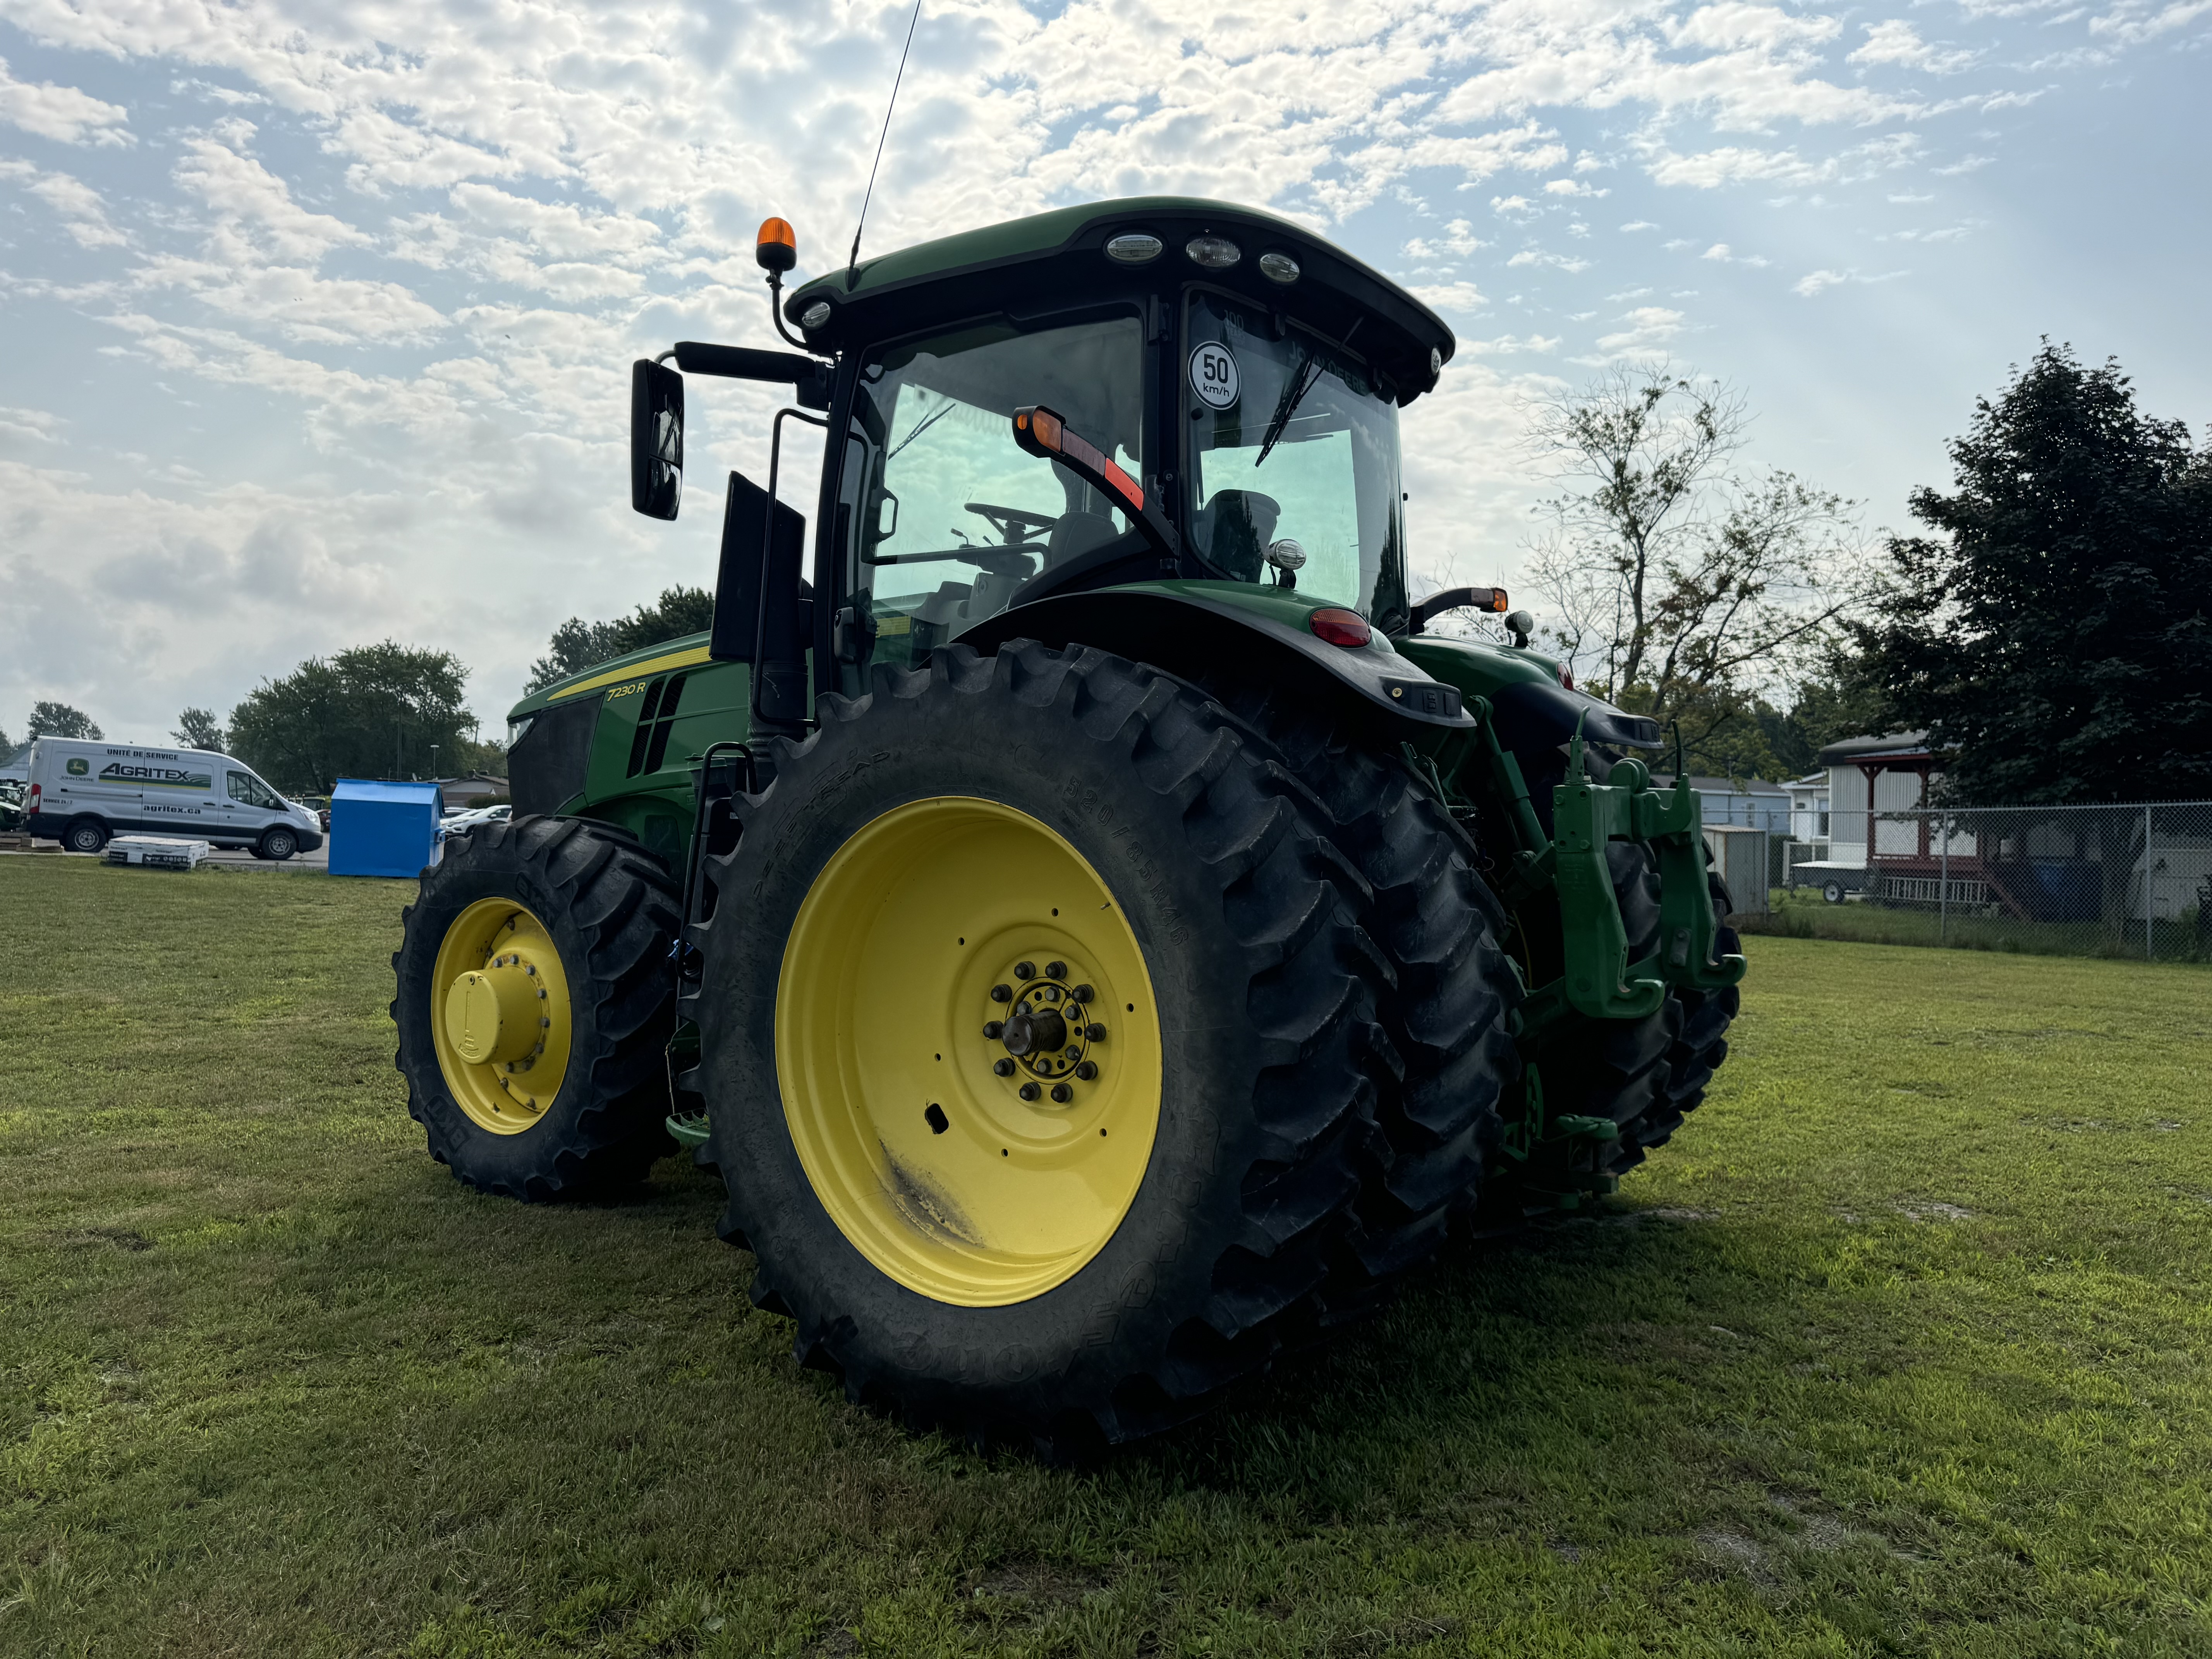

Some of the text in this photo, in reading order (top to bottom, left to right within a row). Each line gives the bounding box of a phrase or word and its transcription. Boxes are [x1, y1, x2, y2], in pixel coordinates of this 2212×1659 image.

[1204, 353, 1228, 384] 50
[1203, 383, 1230, 397] km/h
[607, 682, 646, 702] 7230 R
[107, 748, 131, 757] UNITÉ
[146, 752, 179, 761] SERVICE
[100, 763, 189, 781] AGRITEX
[143, 805, 201, 814] agritex.ca
[1063, 774, 1189, 946] 520/85R46
[517, 877, 555, 927] BKT
[427, 1100, 466, 1150] BKT
